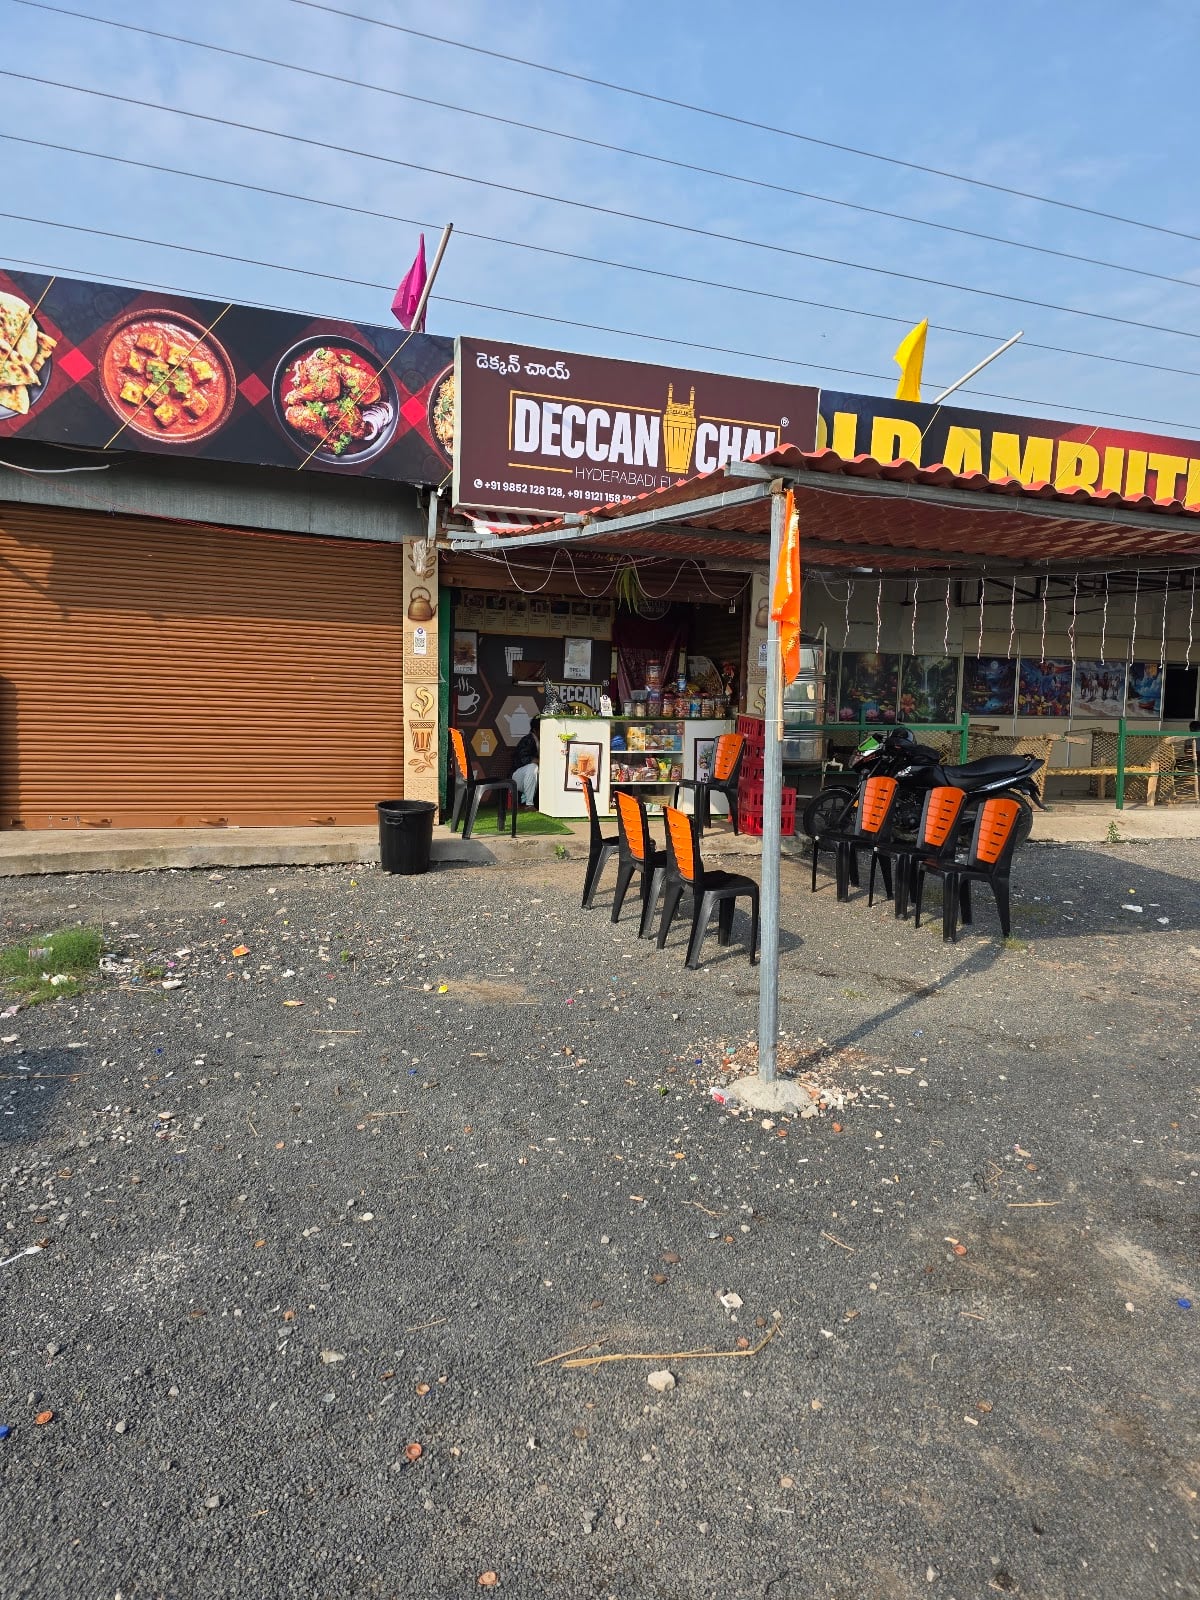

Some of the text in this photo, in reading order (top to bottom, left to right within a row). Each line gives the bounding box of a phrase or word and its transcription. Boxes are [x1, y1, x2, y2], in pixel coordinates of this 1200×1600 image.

[476, 352, 571, 380] డెక్కన్ చాయ్
[514, 397, 776, 474] DECCAN CHAI
[575, 465, 657, 488] HYDERABADI
[484, 480, 501, 491] +91
[502, 482, 528, 494] 9852
[529, 484, 546, 495] 128
[546, 486, 566, 499] 128,
[567, 489, 583, 500] +91
[584, 490, 603, 501] 9121
[604, 492, 621, 503] 158
